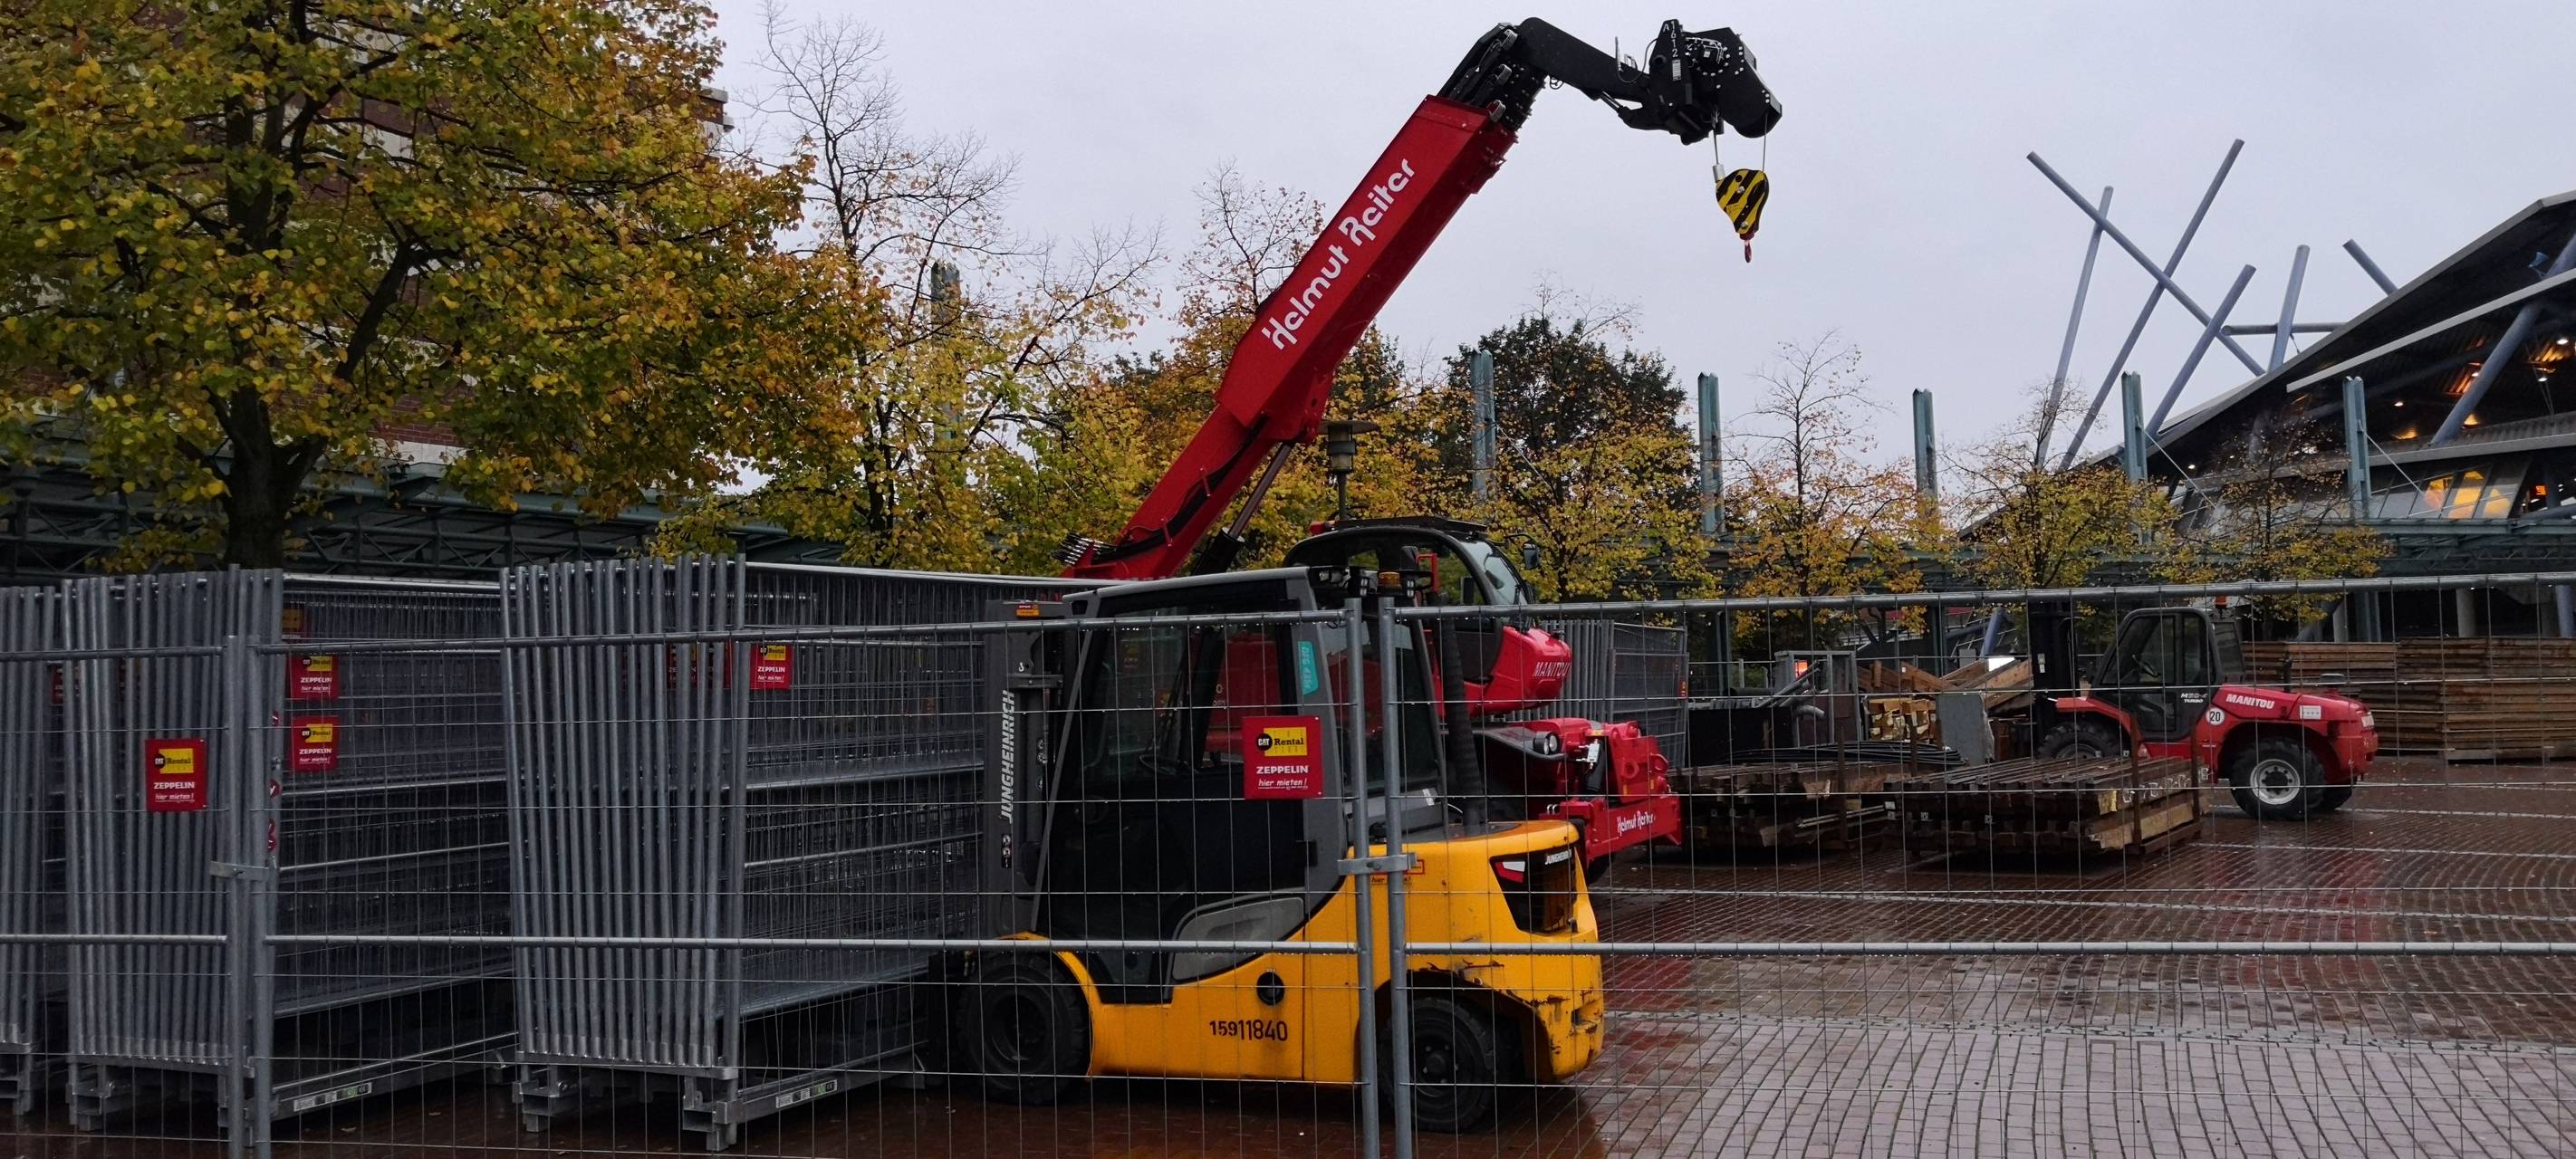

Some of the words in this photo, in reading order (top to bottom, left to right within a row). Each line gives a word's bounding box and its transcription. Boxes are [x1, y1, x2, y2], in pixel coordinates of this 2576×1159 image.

[1261, 244, 1350, 350] Helmut
[1338, 158, 1416, 246] Reiter
[1533, 661, 1571, 677] MANITOU
[2225, 694, 2275, 710] MANITOU
[2210, 711, 2221, 722] 20
[1257, 738, 1270, 746] CAT
[1274, 738, 1304, 746] Rental
[1001, 689, 1015, 825] JUNGHEINRICH
[1256, 765, 1309, 774] ZEPPELIN
[153, 781, 196, 790] ZEPPELIN
[1258, 779, 1274, 787] hier
[1617, 813, 1637, 837] Helmut
[1209, 1019, 1288, 1041] 15911840
